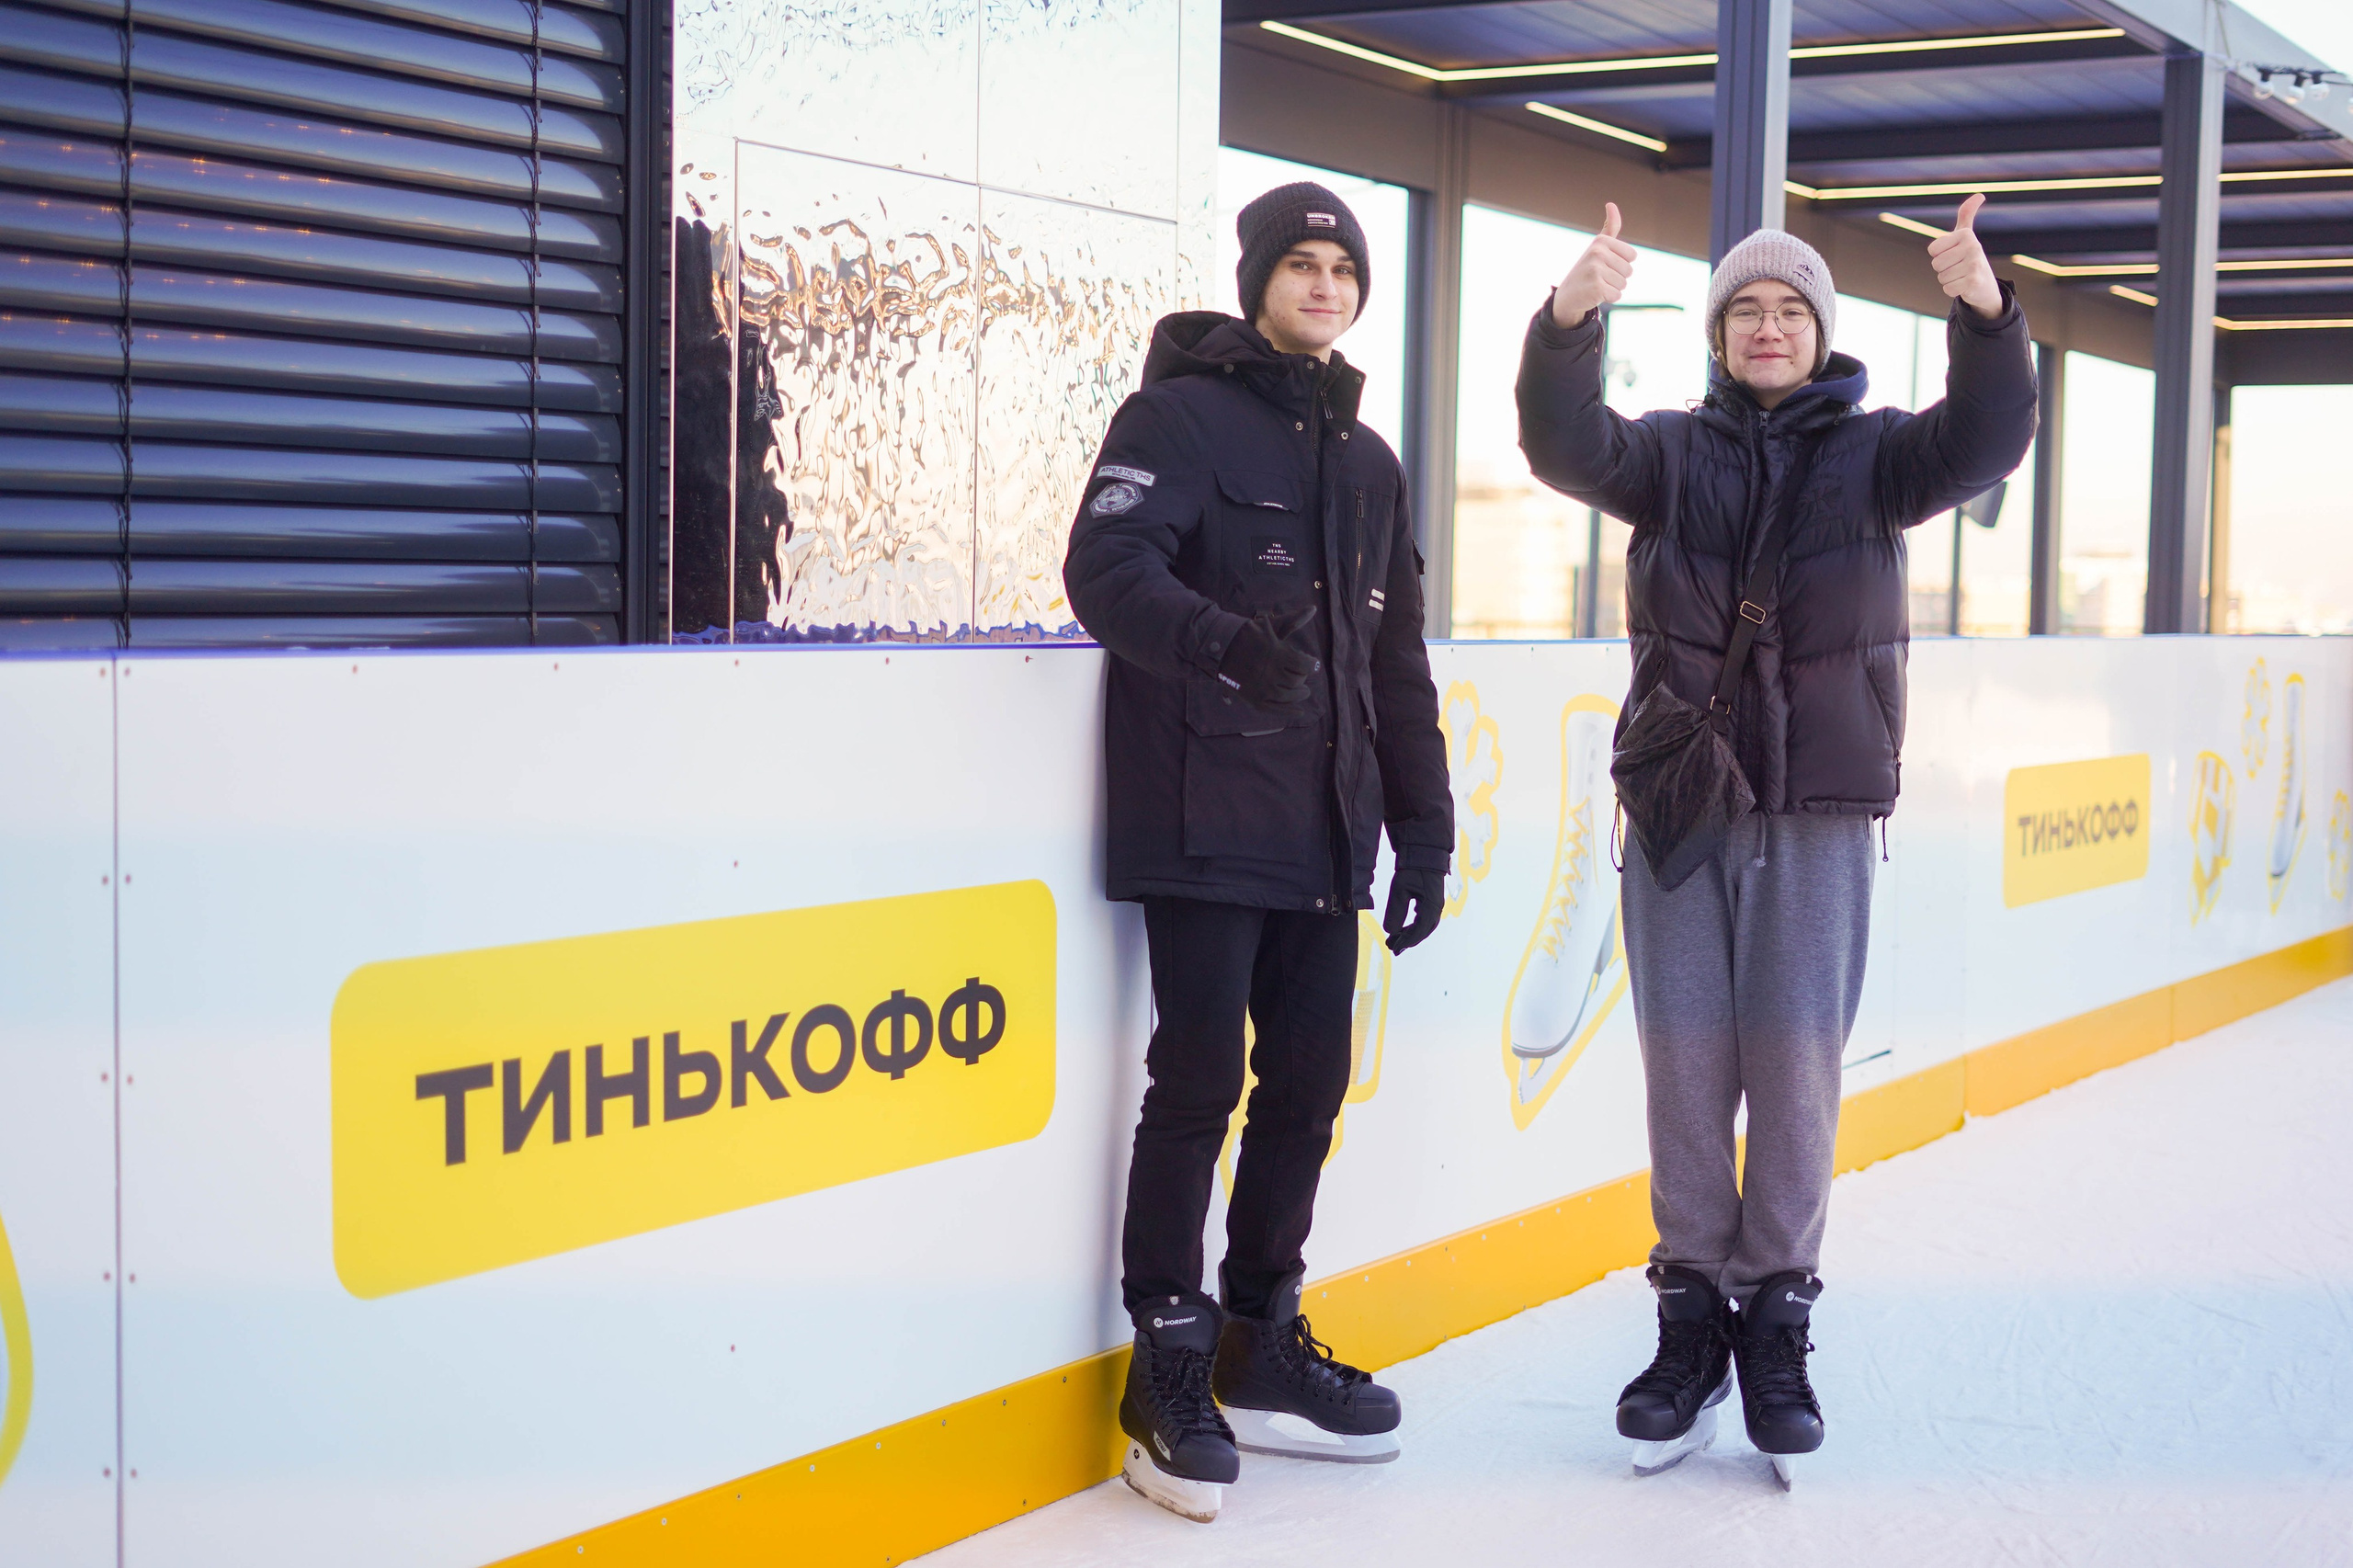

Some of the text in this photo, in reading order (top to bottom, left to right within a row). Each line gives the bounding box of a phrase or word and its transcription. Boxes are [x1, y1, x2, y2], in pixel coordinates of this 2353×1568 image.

[1100, 466, 1135, 477] ATHLETIC
[1136, 472, 1152, 482] THS
[1218, 673, 1241, 690] SPORT
[2018, 798, 2139, 858] ТИНЬКОФФ
[415, 976, 1006, 1167] ТИНЬКОФФ
[1164, 1315, 1198, 1325] NORDWAY
